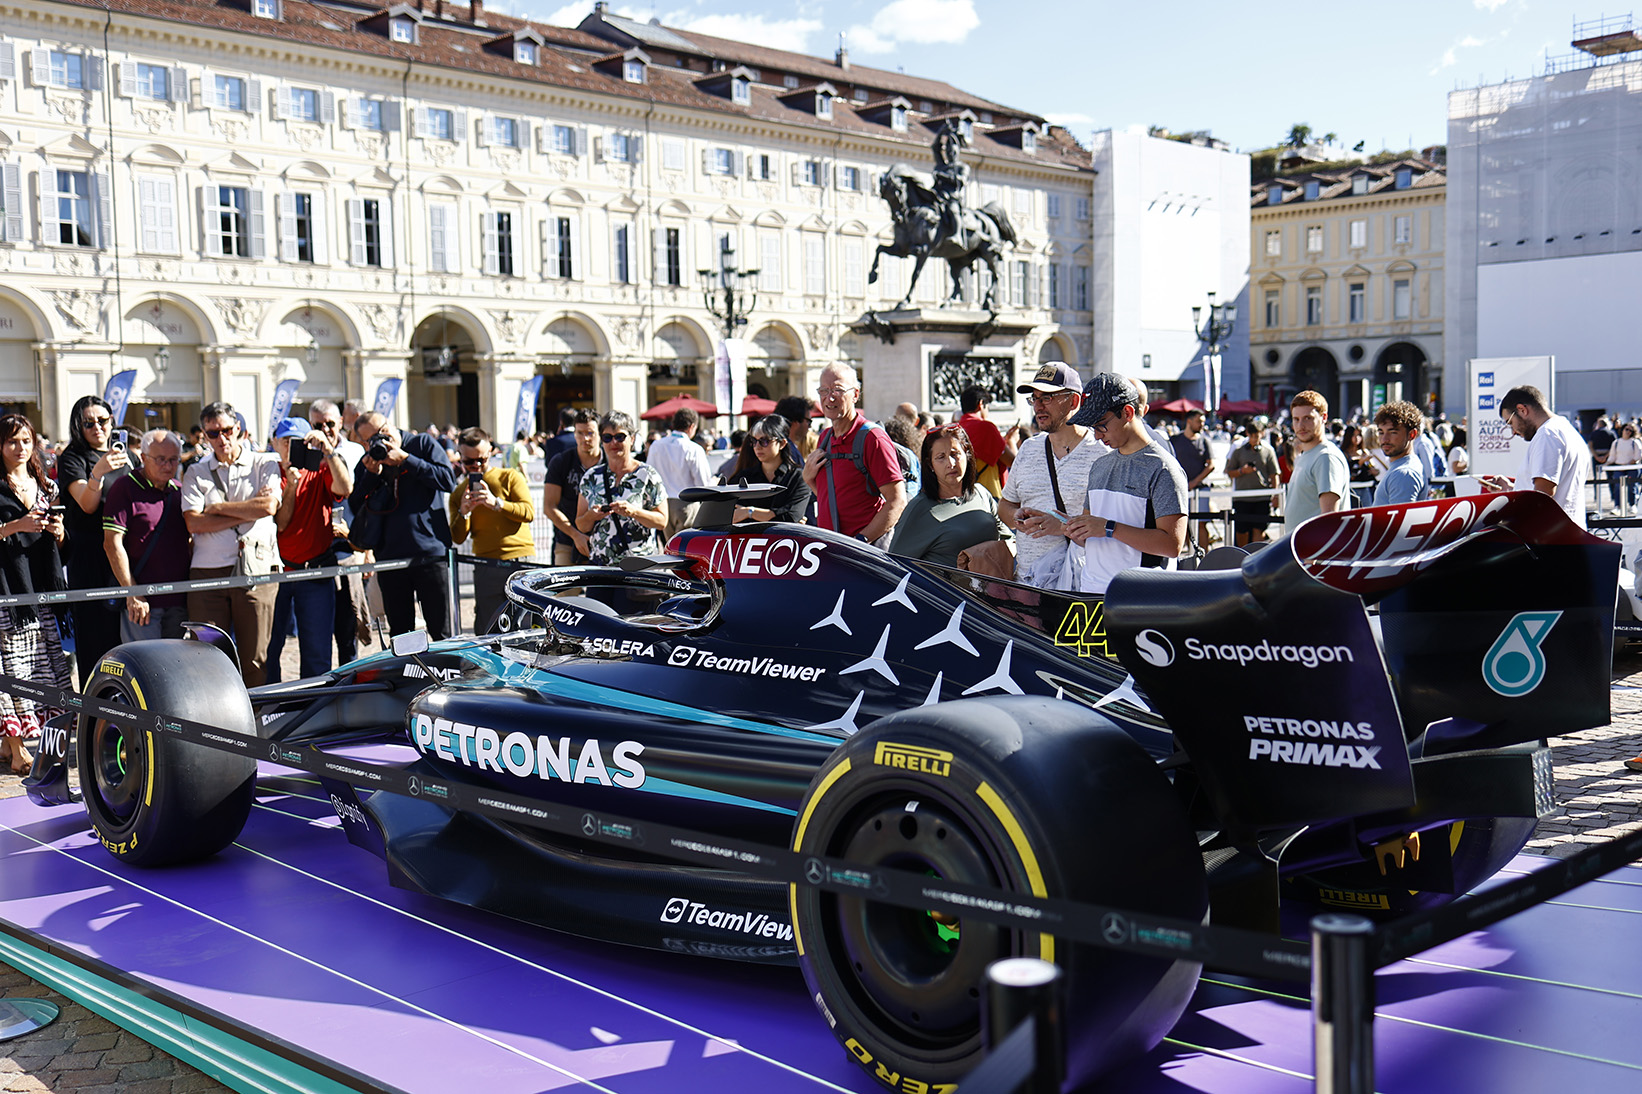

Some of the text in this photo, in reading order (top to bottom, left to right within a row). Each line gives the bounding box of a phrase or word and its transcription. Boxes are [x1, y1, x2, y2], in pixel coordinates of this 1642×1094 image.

[1479, 375, 1493, 384] Rai
[1479, 398, 1493, 407] Rai
[1479, 441, 1510, 450] 2024
[708, 538, 828, 577] INEOS
[668, 578, 692, 591] INEOS
[543, 604, 572, 623] AMD
[1054, 602, 1117, 657] 44
[593, 638, 655, 658] SOLERA
[1184, 637, 1354, 669] Snapdragon
[100, 660, 126, 677] PIRELLI
[695, 650, 827, 683] TeamViewer
[38, 726, 67, 758] IWC
[1243, 715, 1375, 741] PETRONAS
[413, 713, 646, 789] PETRONAS
[873, 741, 954, 777] PIRELLI
[1248, 738, 1382, 770] PRIMAX
[92, 824, 138, 855] P ZERO
[1319, 887, 1391, 909] PIRELLI
[687, 902, 794, 942] TeamView
